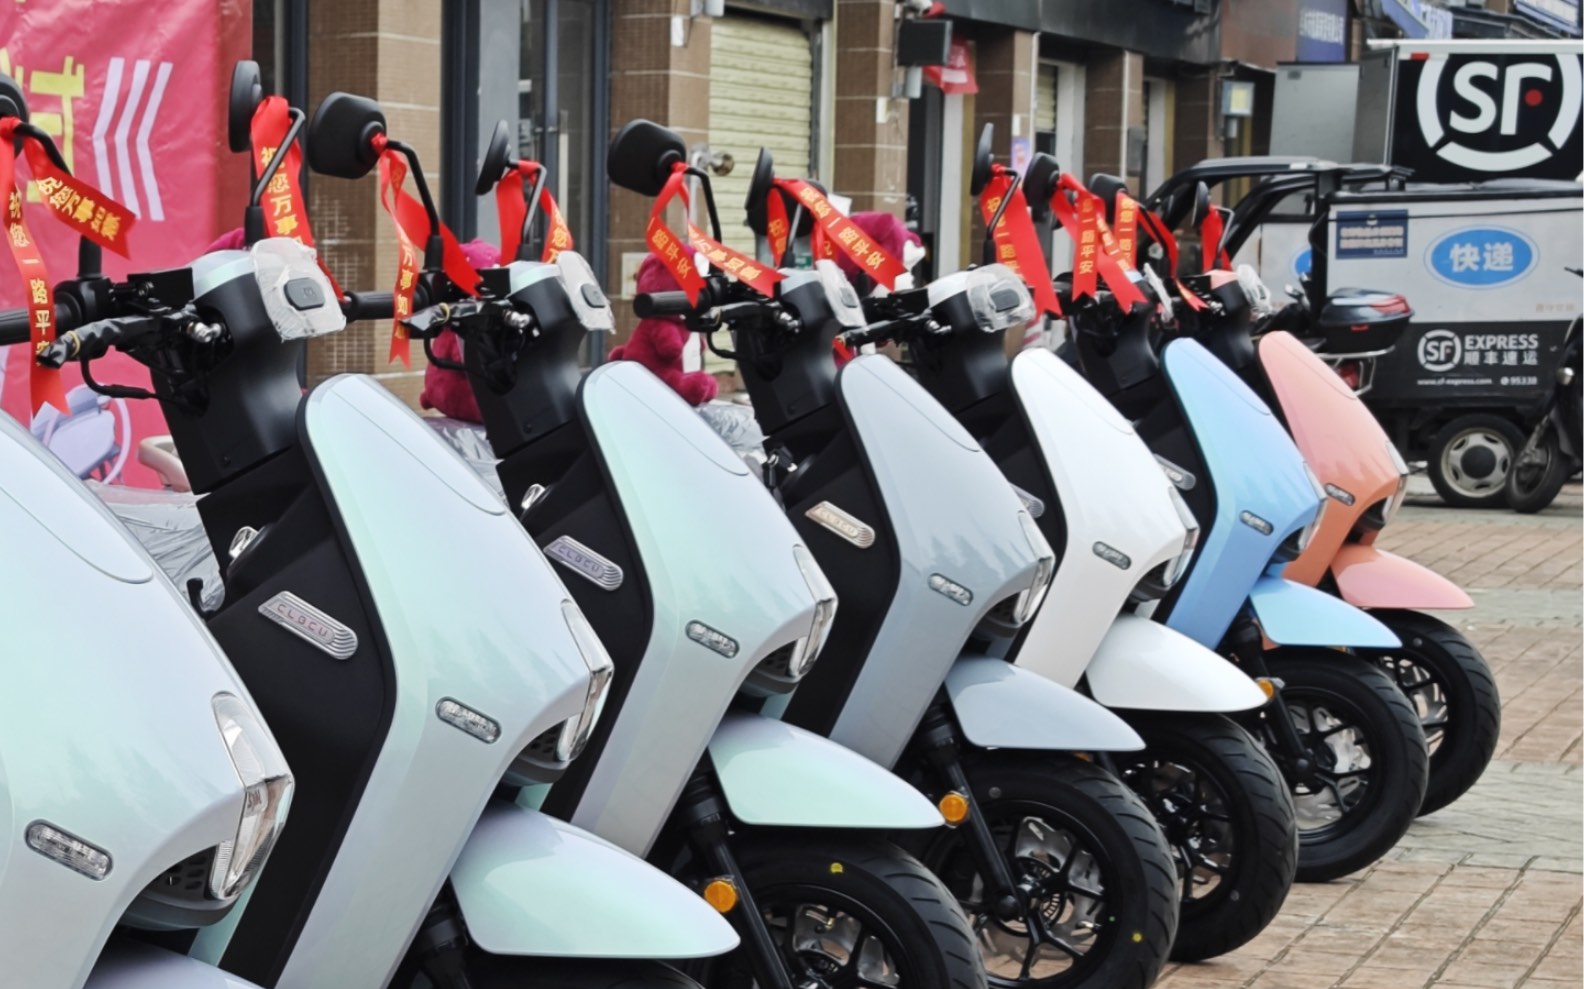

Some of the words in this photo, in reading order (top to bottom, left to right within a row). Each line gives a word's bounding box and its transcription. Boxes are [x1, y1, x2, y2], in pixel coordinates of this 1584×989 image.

[1448, 60, 1554, 136] SF
[1449, 242, 1515, 273] 快递
[1464, 334, 1538, 350] EXPRESS
